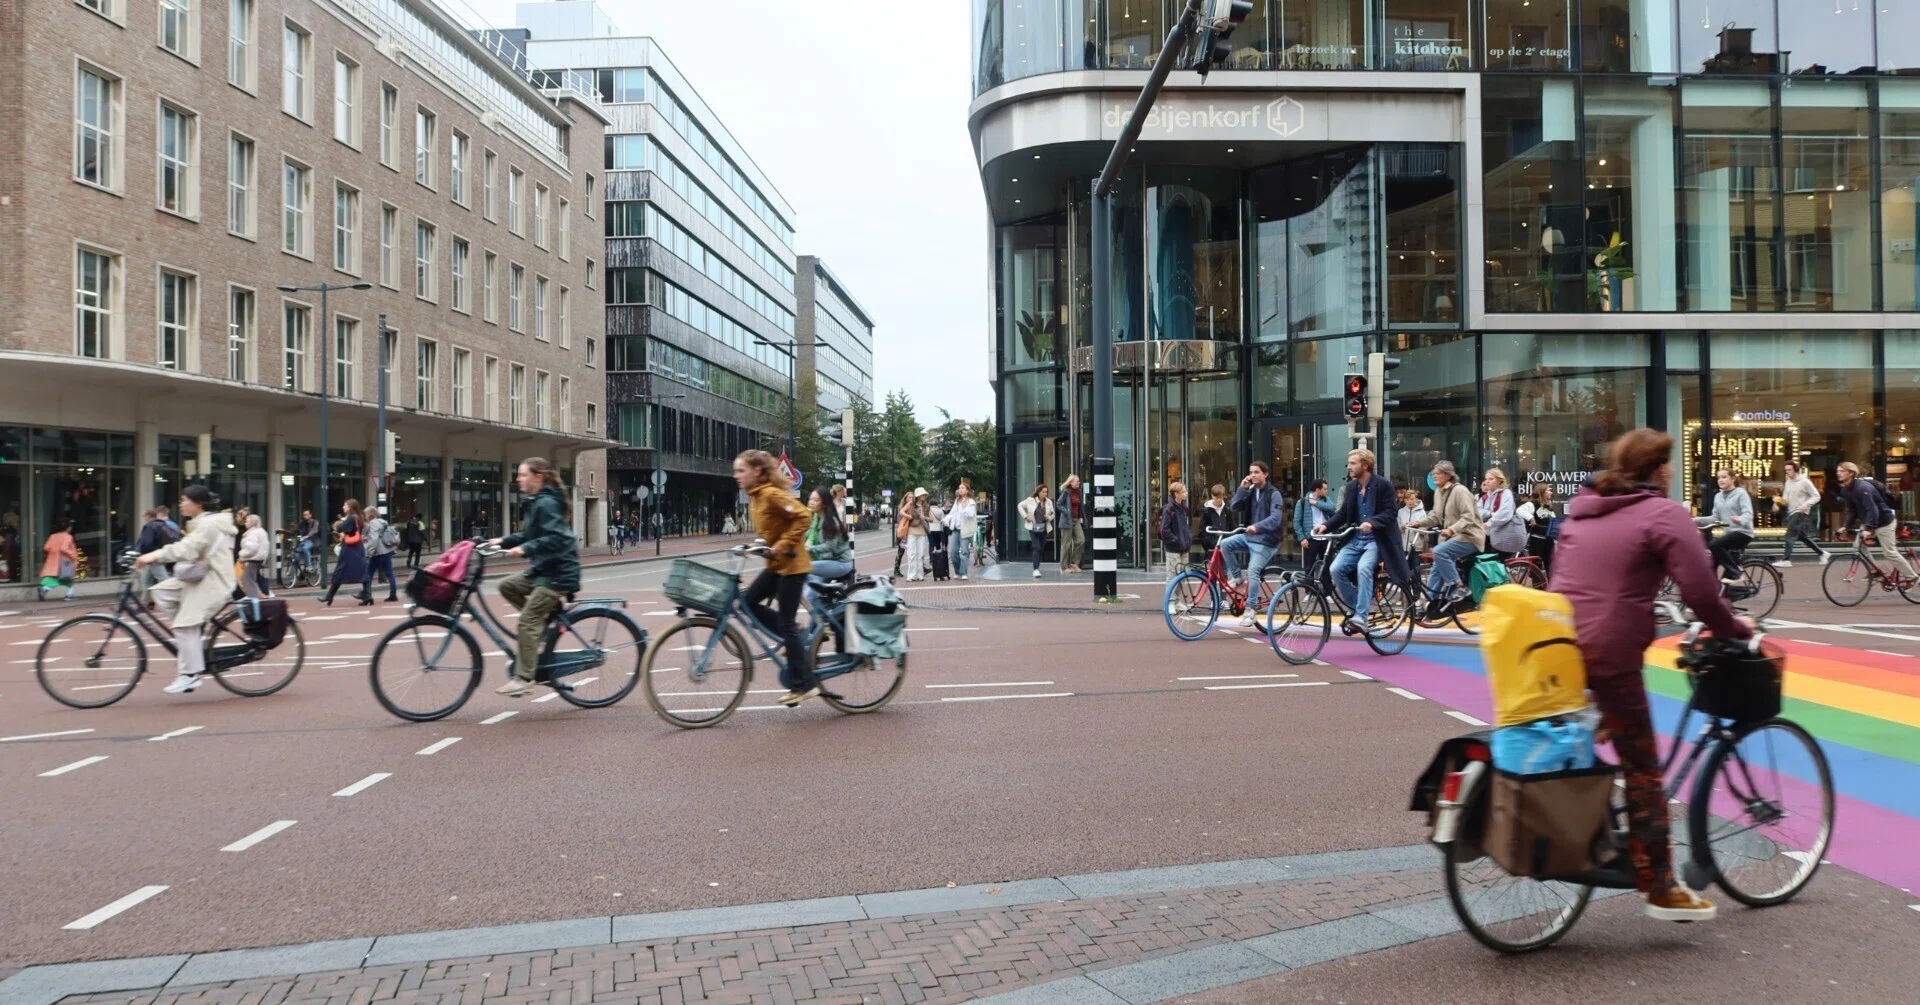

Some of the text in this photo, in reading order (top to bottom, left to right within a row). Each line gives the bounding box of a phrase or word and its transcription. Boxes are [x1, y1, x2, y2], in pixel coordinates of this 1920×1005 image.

[1394, 25, 1424, 36] the
[1296, 44, 1337, 55] bezoek
[1394, 41, 1463, 55] kitchen
[1489, 48, 1504, 59] op
[1508, 46, 1522, 56] de
[1539, 47, 1569, 59] etage
[1103, 104, 1260, 133] de Bijenkorf
[1526, 471, 1557, 482] KOM
[1517, 483, 1533, 496] BIJ
[1556, 483, 1584, 496] BIJE
